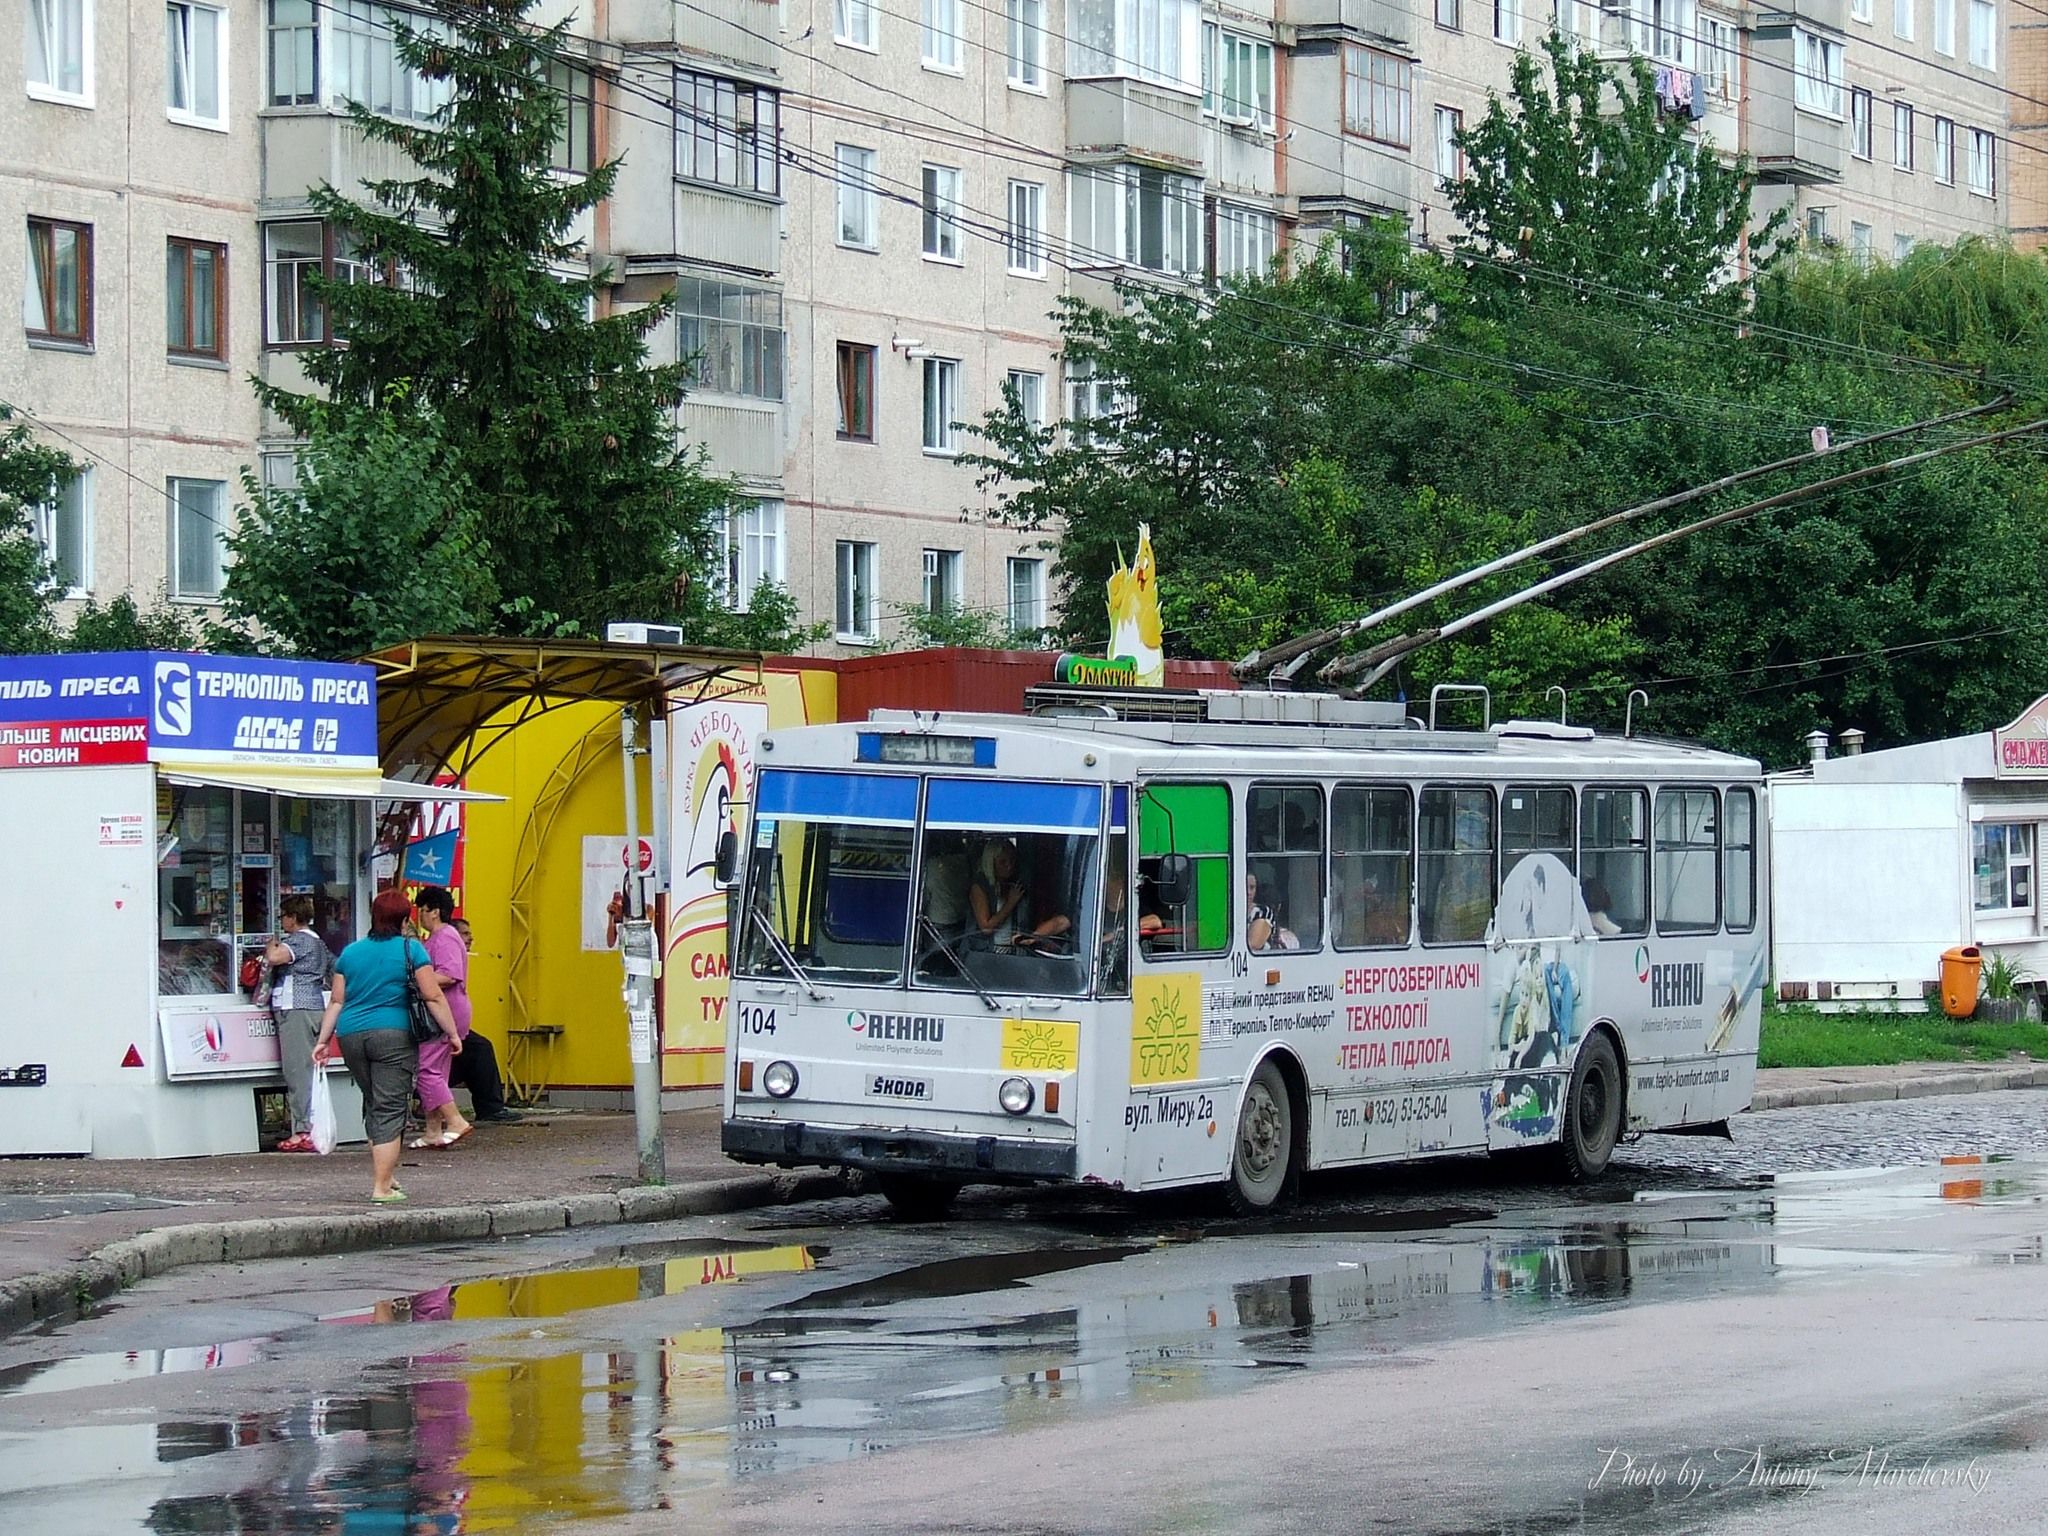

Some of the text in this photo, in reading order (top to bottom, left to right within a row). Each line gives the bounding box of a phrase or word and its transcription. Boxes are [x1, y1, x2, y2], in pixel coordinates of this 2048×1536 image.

[60, 676, 140, 698] ПРЕСА
[197, 671, 369, 705] ТЕРНОПІЛЬ ПРЕСА
[60, 725, 147, 745] МІСЦЕВИХ
[18, 747, 79, 764] НОВИН
[684, 760, 697, 814] КУРКА
[1231, 951, 1248, 977] 104
[1345, 963, 1480, 995] ЕНЕРГОЗБЕРІГАЮЧІ
[1651, 962, 1704, 1008] REHAU
[700, 996, 729, 1021] ТУ
[1254, 990, 1306, 1011] представник
[1307, 984, 1334, 1003] REHAU
[740, 1007, 776, 1036] 104
[868, 1014, 944, 1042] REHAU
[1346, 997, 1428, 1033] ТЕХНОЛОГІЇ
[855, 1042, 944, 1057] Unlimited Polymer Solutions
[1011, 1050, 1066, 1070] ТТК
[1140, 1042, 1191, 1078] ТТК
[1341, 1037, 1450, 1071] ТЕПЛА ПІДЛОГА
[872, 1076, 926, 1097] ŠKODA
[1636, 1068, 1730, 1093] www.teplo-komfort.com.ua
[1124, 1103, 1153, 1133] вул.
[1197, 1093, 1213, 1121] 2а
[1335, 1107, 1360, 1129] тел.
[1400, 1094, 1448, 1123] 53-25-04
